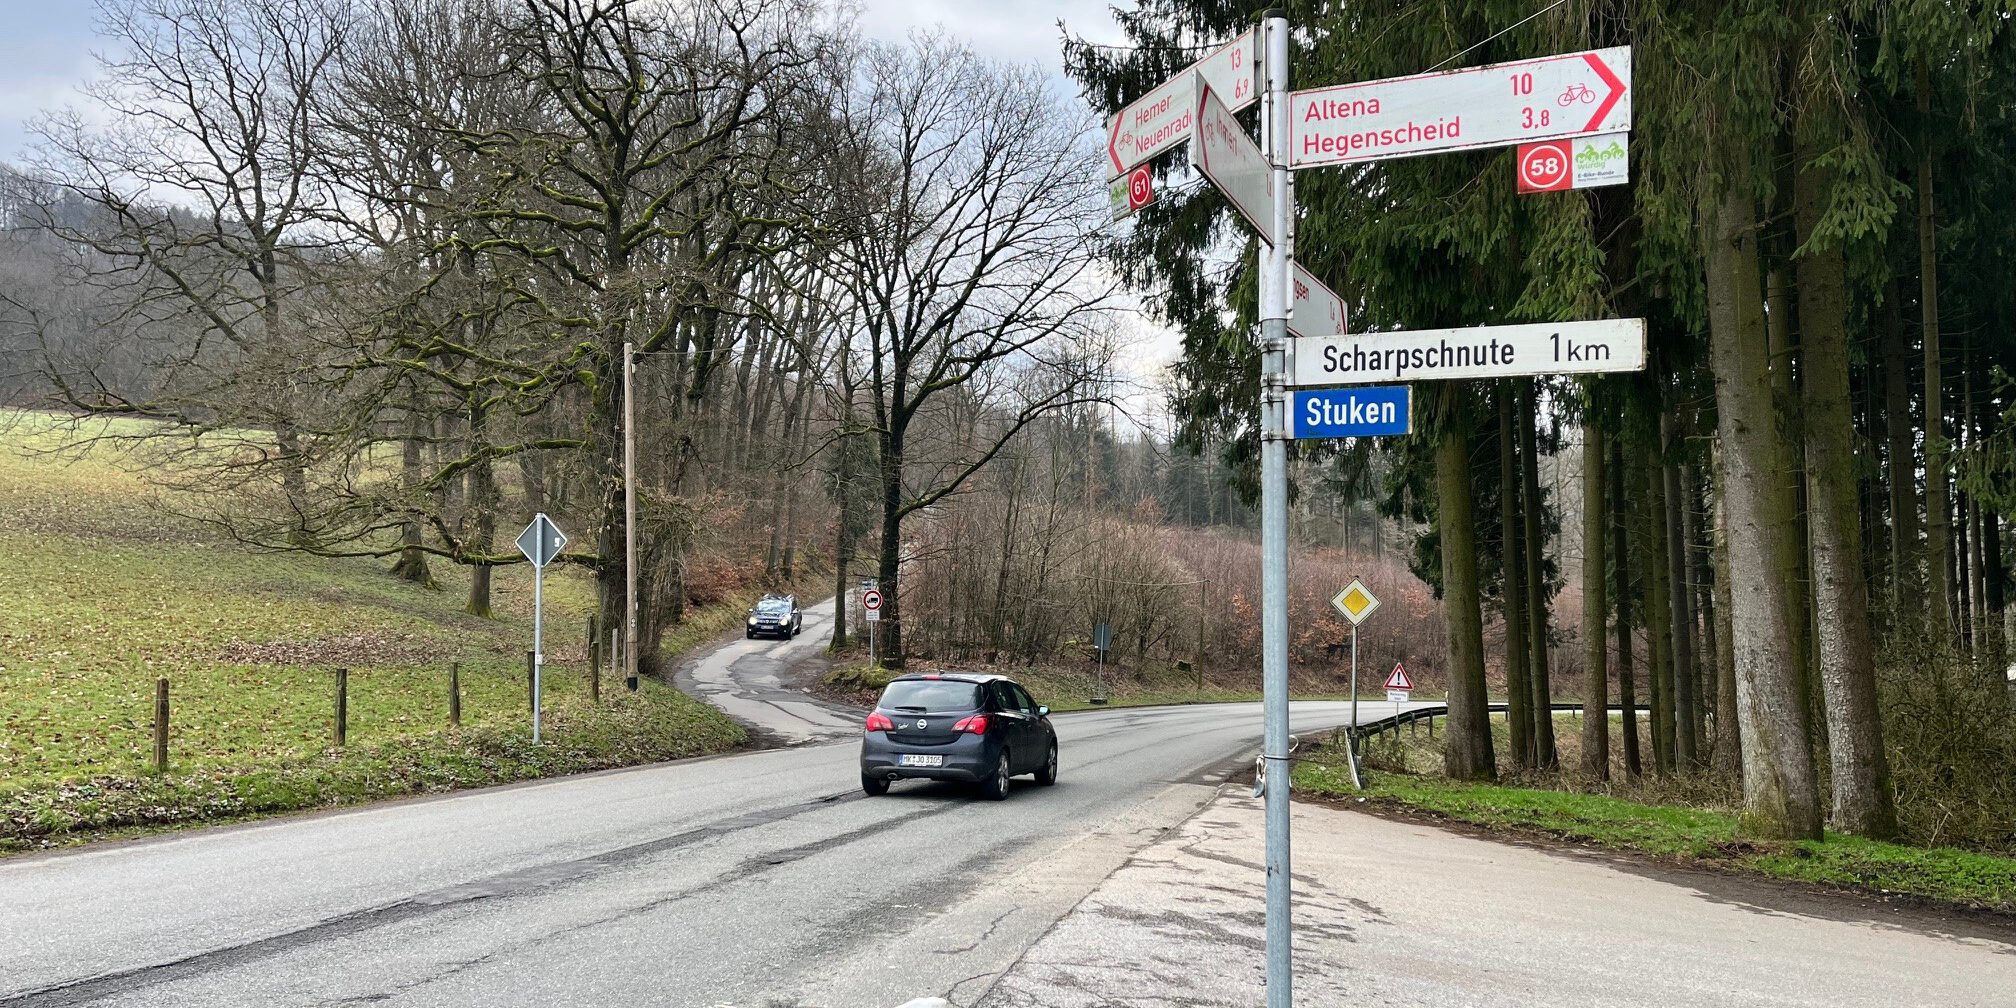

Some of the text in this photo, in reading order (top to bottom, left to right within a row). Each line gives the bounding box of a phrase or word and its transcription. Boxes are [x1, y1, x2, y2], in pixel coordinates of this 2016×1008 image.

[1230, 49, 1241, 71] 13
[1510, 72, 1533, 96] 10
[1135, 94, 1172, 126] Hemer
[1305, 98, 1380, 122] Altena
[1521, 107, 1550, 129] 3,8
[1135, 108, 1192, 156] Neuenrad
[1304, 116, 1461, 156] Hegenscheid
[1530, 157, 1559, 176] 58
[1134, 178, 1146, 196] 61
[1323, 338, 1515, 377] Scharpschnute
[1306, 396, 1396, 426] Stuken
